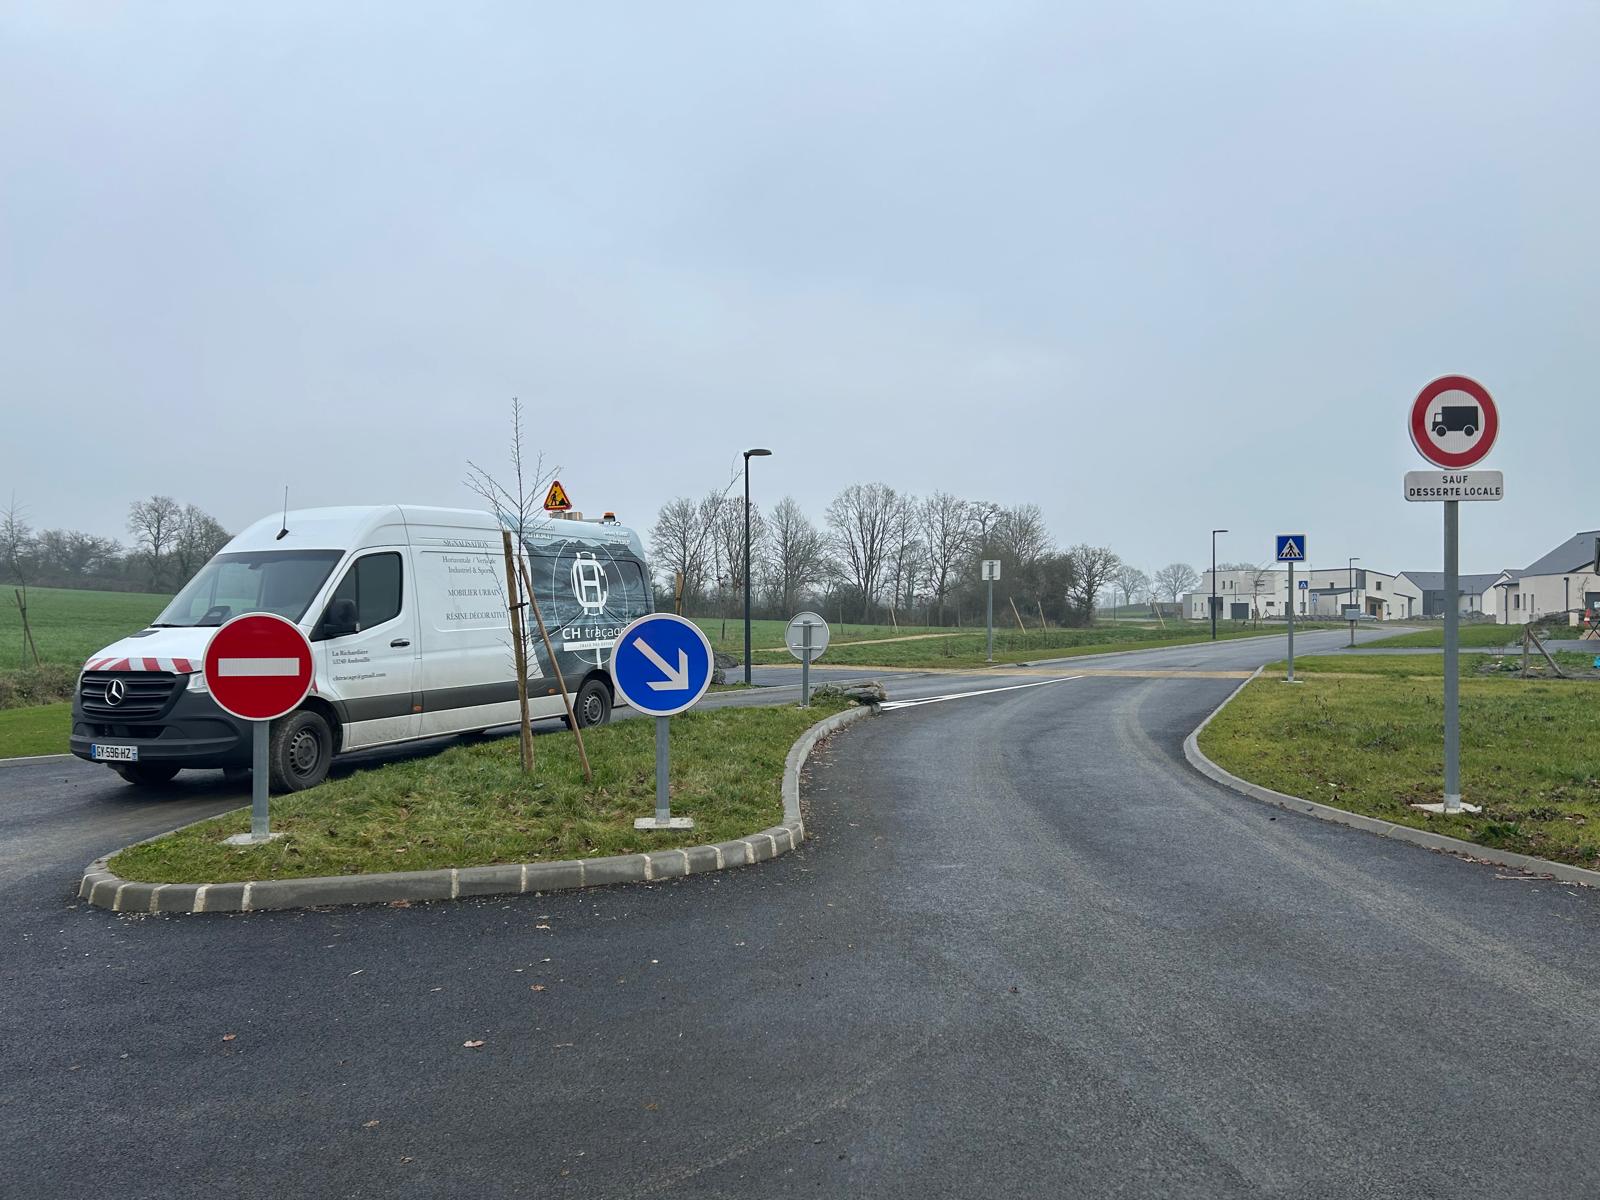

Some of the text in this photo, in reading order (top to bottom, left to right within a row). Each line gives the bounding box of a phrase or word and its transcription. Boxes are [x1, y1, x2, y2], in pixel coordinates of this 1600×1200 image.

[1442, 475, 1469, 484] SAUF
[1409, 486, 1501, 497] DESSERTE LOCALE
[447, 588, 478, 597] MOBILIER
[562, 627, 581, 640] CH
